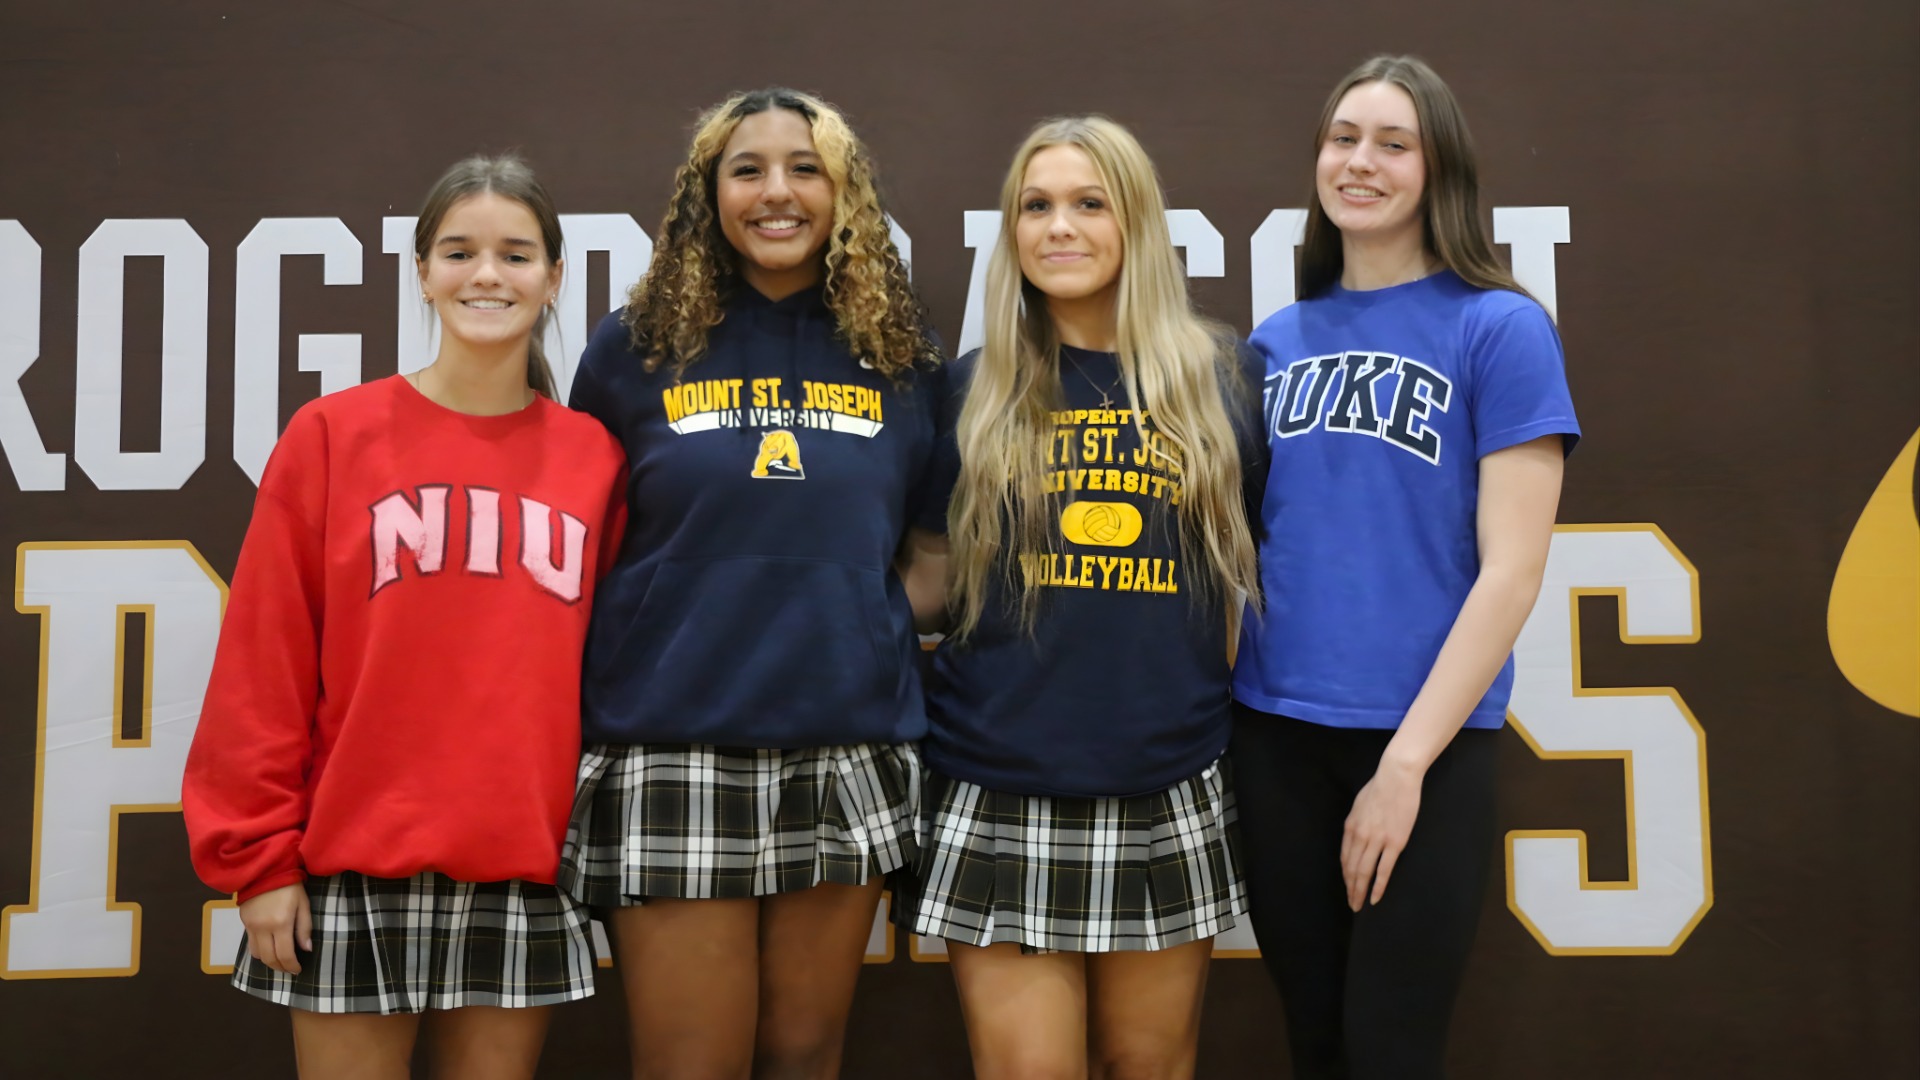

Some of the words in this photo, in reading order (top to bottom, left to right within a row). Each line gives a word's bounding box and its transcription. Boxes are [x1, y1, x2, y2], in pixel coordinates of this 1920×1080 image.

[663, 379, 743, 424] MOUNT
[752, 378, 791, 408] ST.
[802, 380, 883, 422] JOSEPH
[718, 408, 836, 430] UNVERSITY
[1049, 409, 1151, 424] ROPERTY
[1083, 427, 1125, 464] ST.
[1022, 469, 1183, 506] NIVERSITY
[368, 483, 589, 607] NIU
